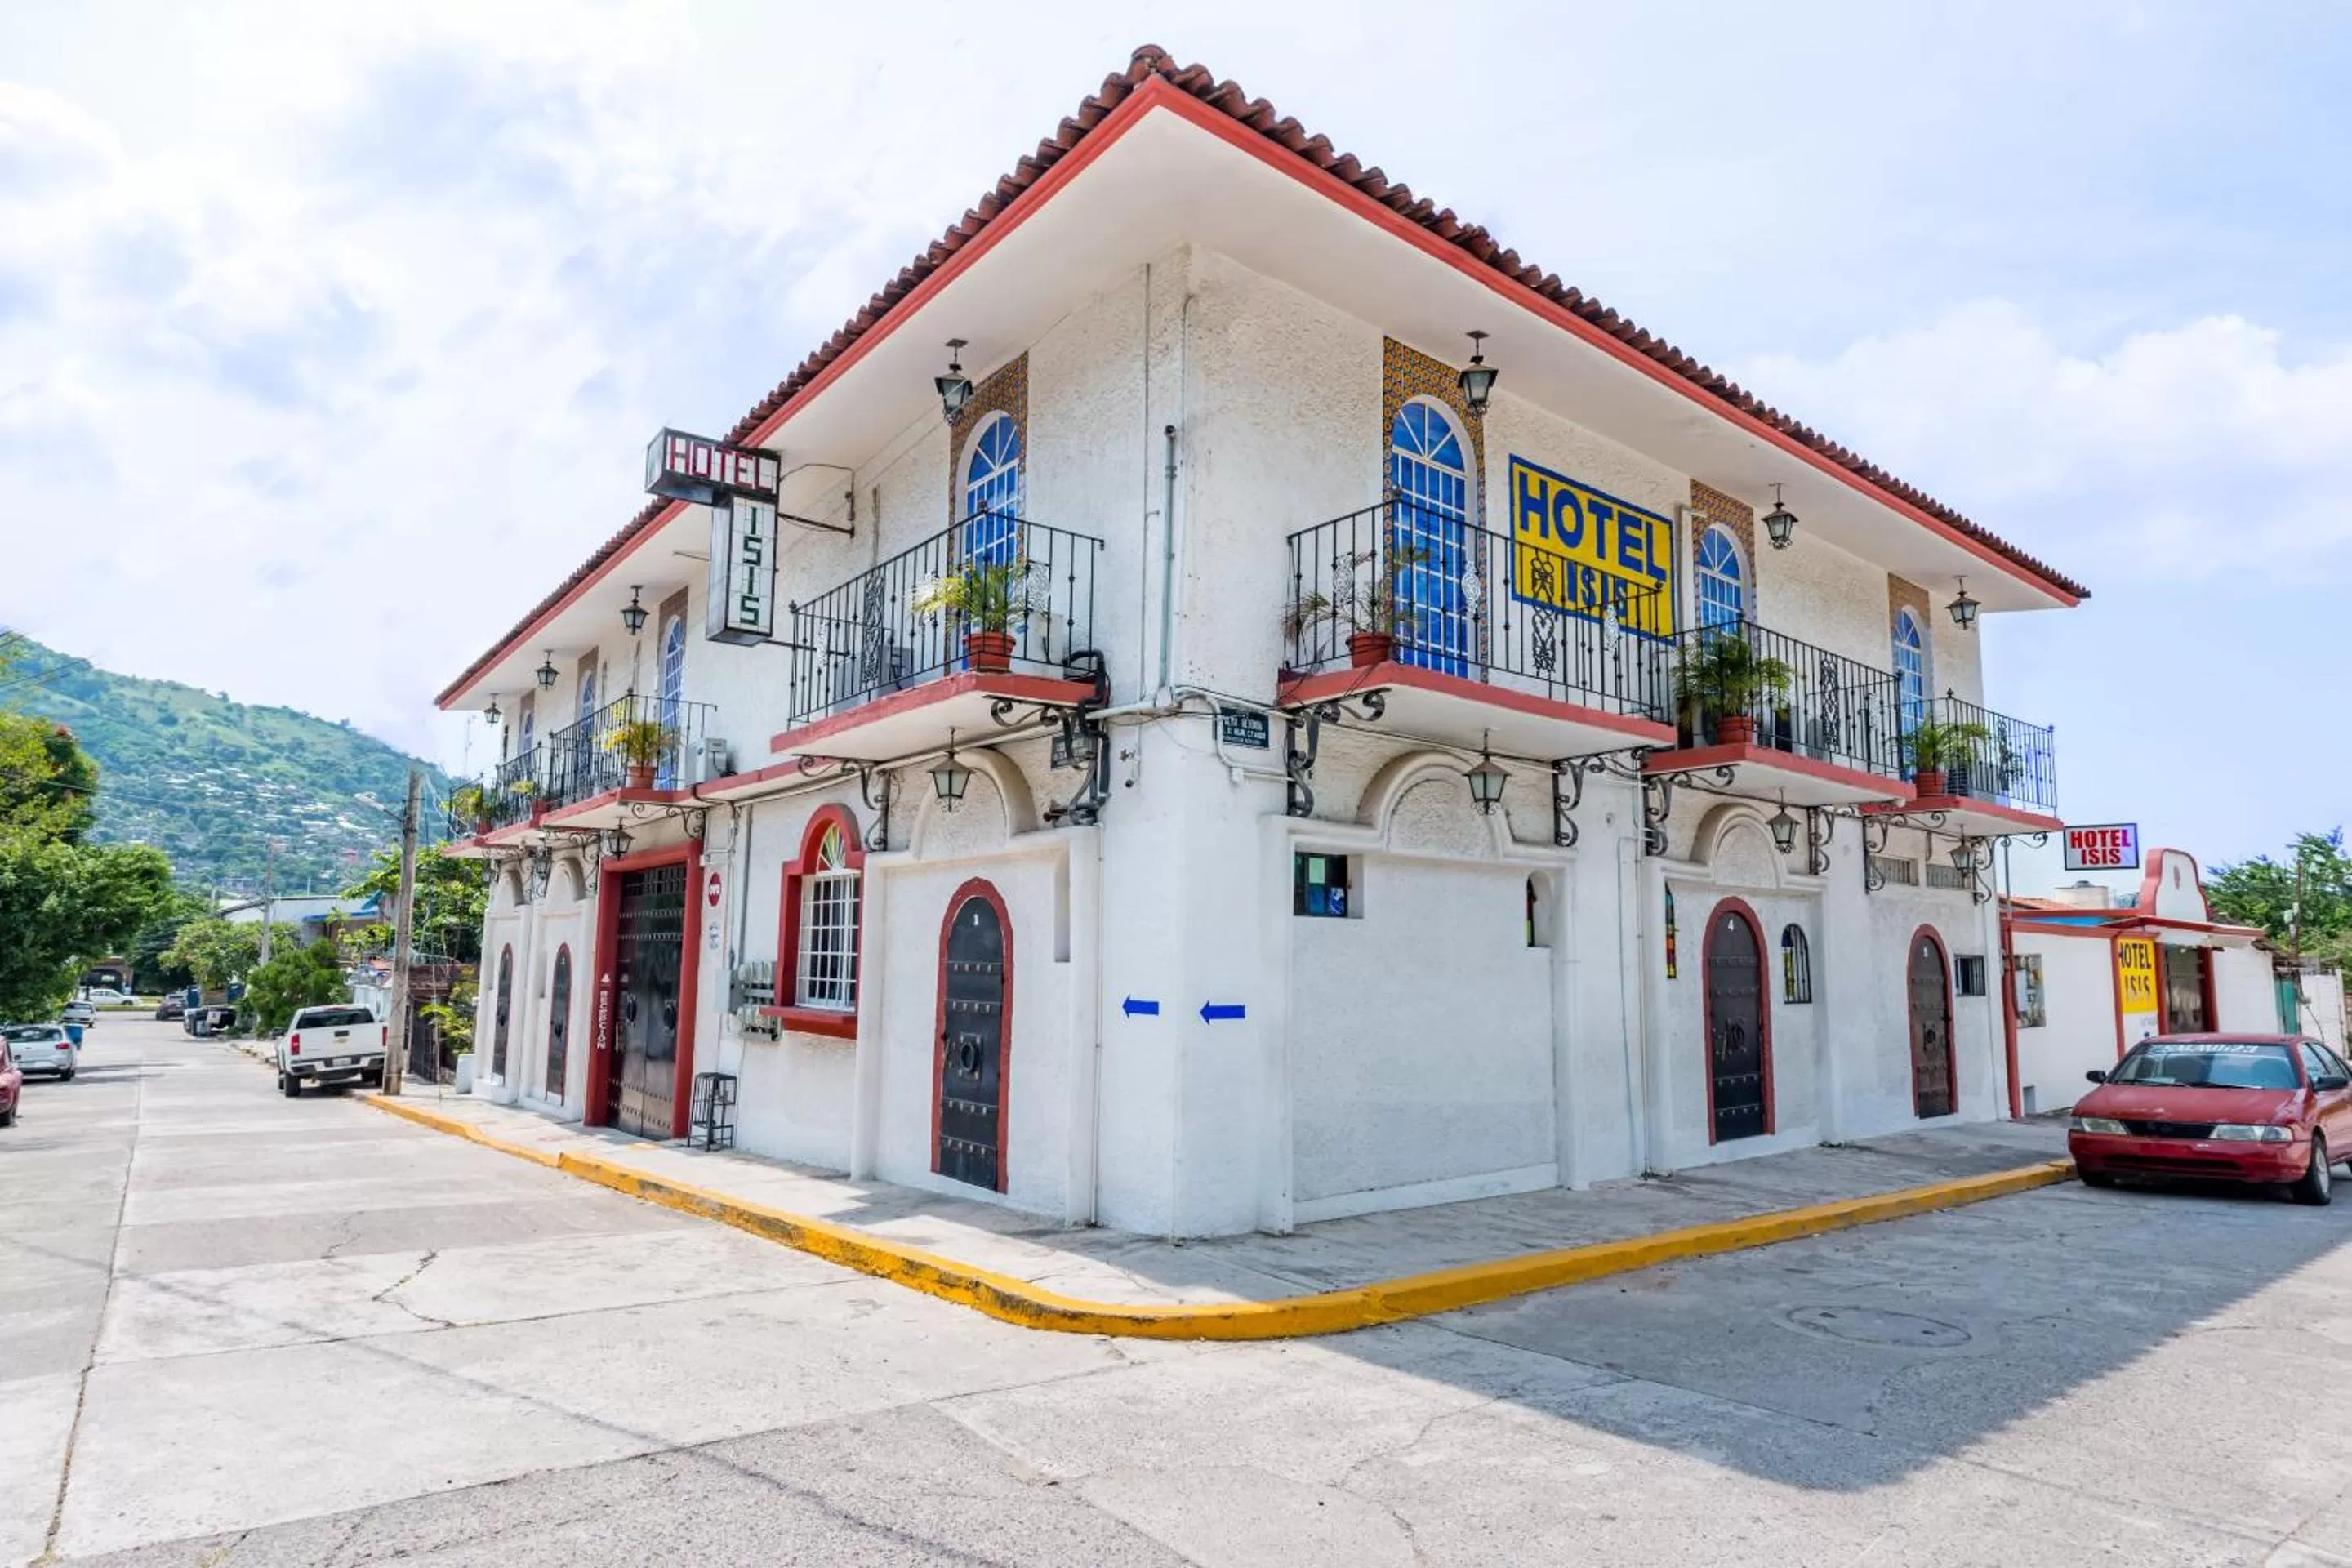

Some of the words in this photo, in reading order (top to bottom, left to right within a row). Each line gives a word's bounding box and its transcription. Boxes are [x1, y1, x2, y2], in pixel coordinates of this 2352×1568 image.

[668, 436, 773, 492] HOTEL
[1518, 470, 1667, 582] HOTEL
[739, 506, 763, 626] ISIS
[1566, 559, 1628, 618] ISIS
[2069, 829, 2132, 849] HOTEL
[2081, 848, 2122, 866] ISIS
[2125, 973, 2151, 999] ISIS
